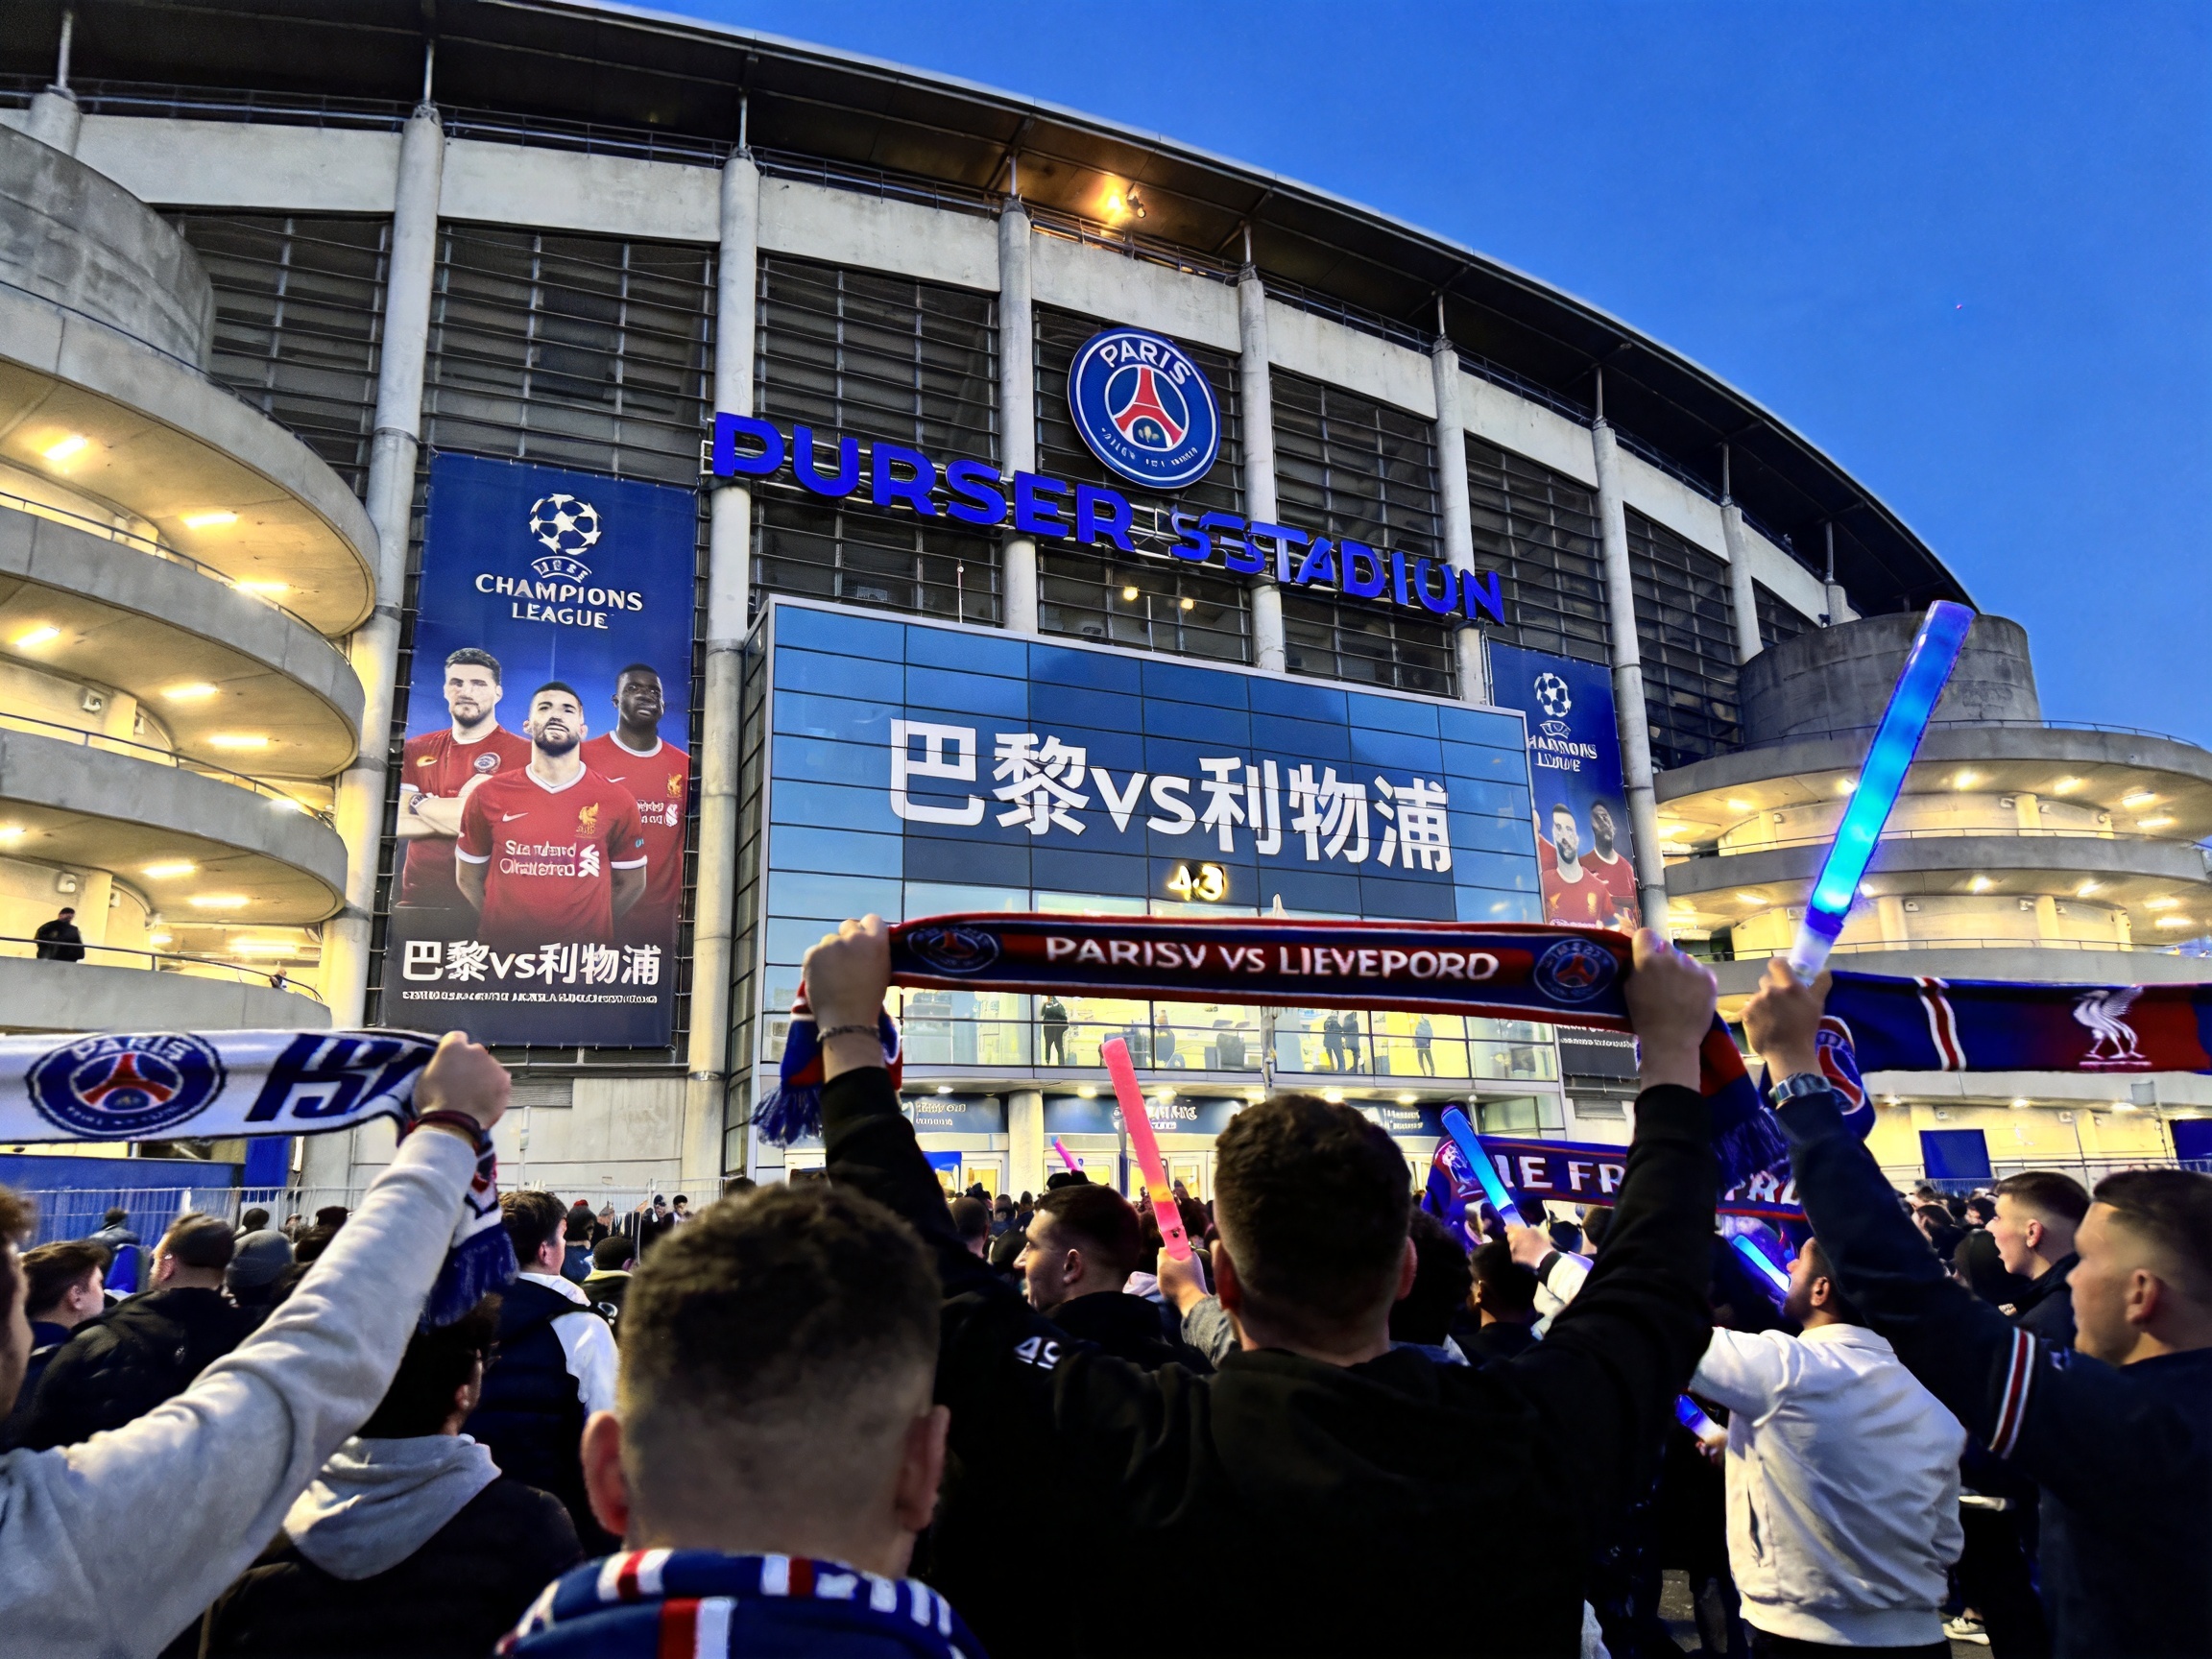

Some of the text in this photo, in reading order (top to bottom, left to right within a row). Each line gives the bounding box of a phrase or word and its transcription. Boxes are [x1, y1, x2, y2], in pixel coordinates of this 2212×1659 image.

[1099, 339, 1191, 385] PARIS
[712, 412, 1136, 552] PURSER
[475, 573, 643, 612] CHAMPIONS
[512, 601, 609, 630] LEAGUE
[1046, 936, 1500, 981] PARISV VS LIEVEPORD
[71, 1033, 192, 1062] PARIS
